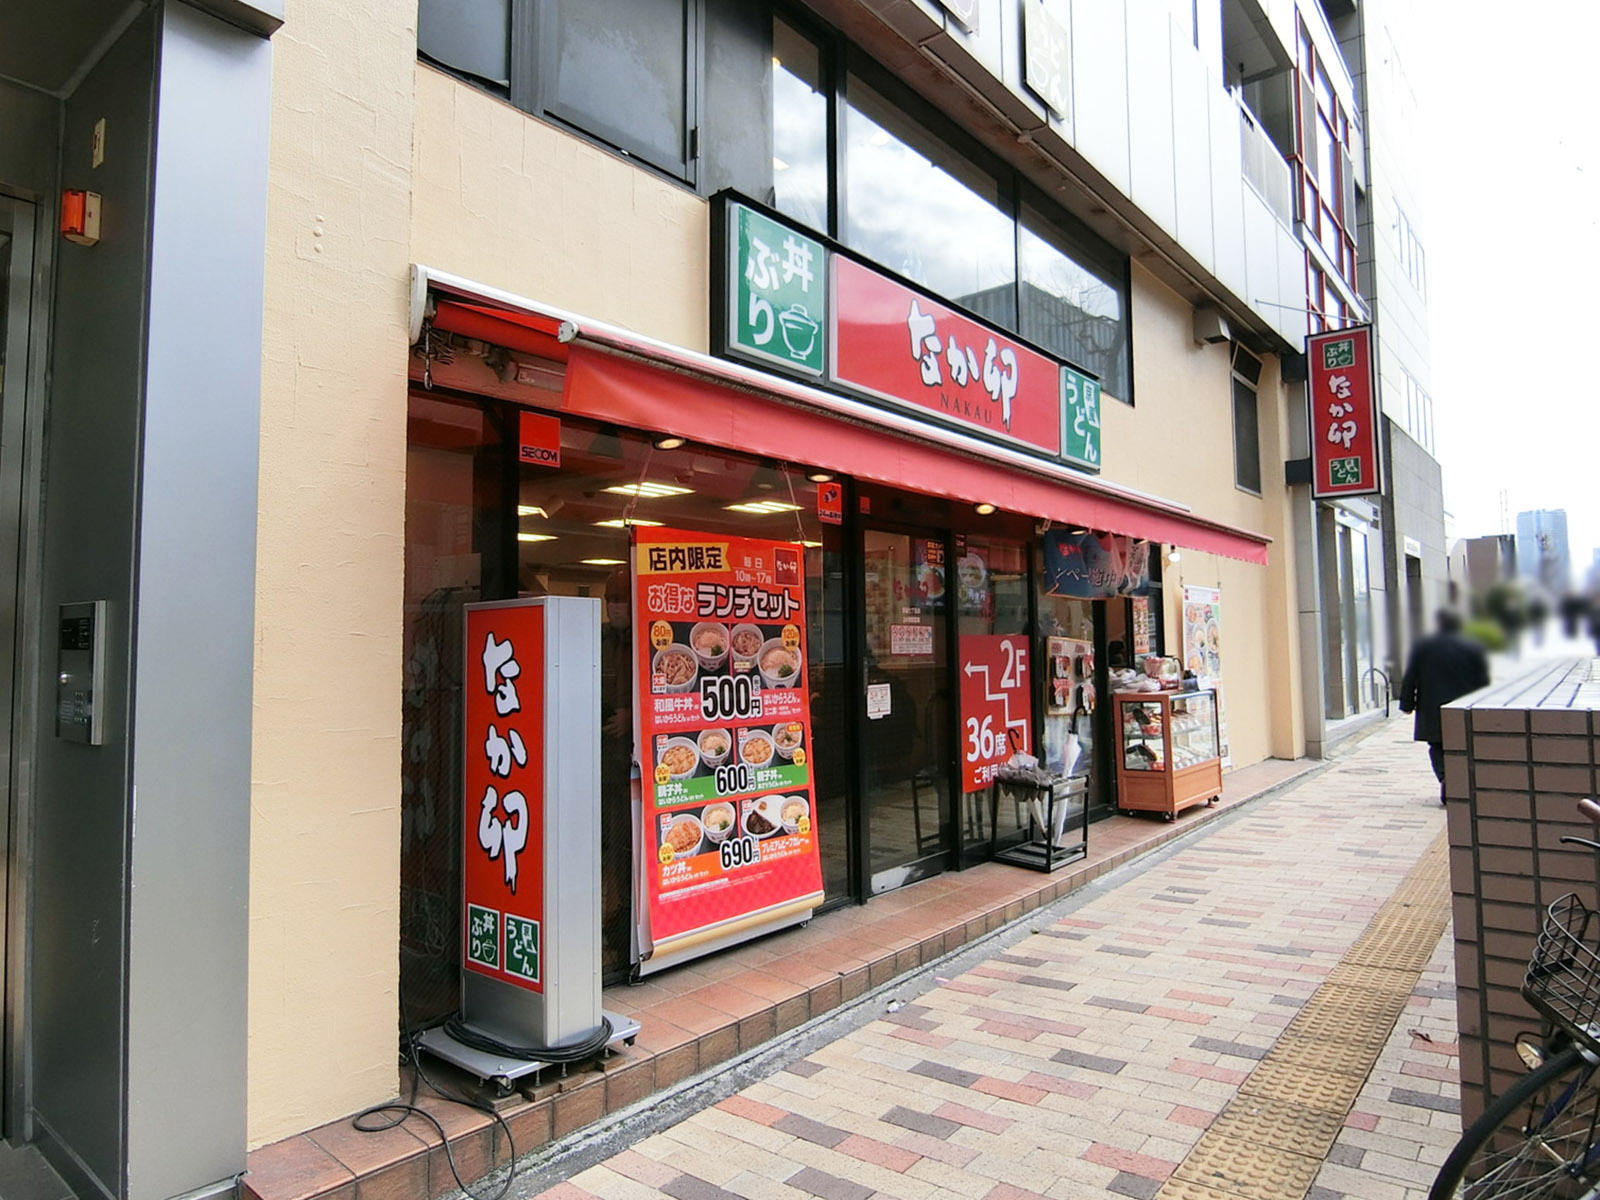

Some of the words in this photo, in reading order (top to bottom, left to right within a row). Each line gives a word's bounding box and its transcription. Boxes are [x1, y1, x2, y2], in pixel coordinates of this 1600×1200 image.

[907, 298, 1018, 432] なか卯
[940, 391, 992, 424] NAKAU
[1327, 374, 1358, 450] なか卯
[521, 446, 558, 463] SECOM
[649, 547, 723, 571] 店内限定
[648, 583, 695, 614] お得な
[697, 582, 800, 619] ランチセット
[1000, 639, 1026, 688] 2F
[478, 631, 530, 894] なか卯
[966, 714, 1007, 763] 36席
